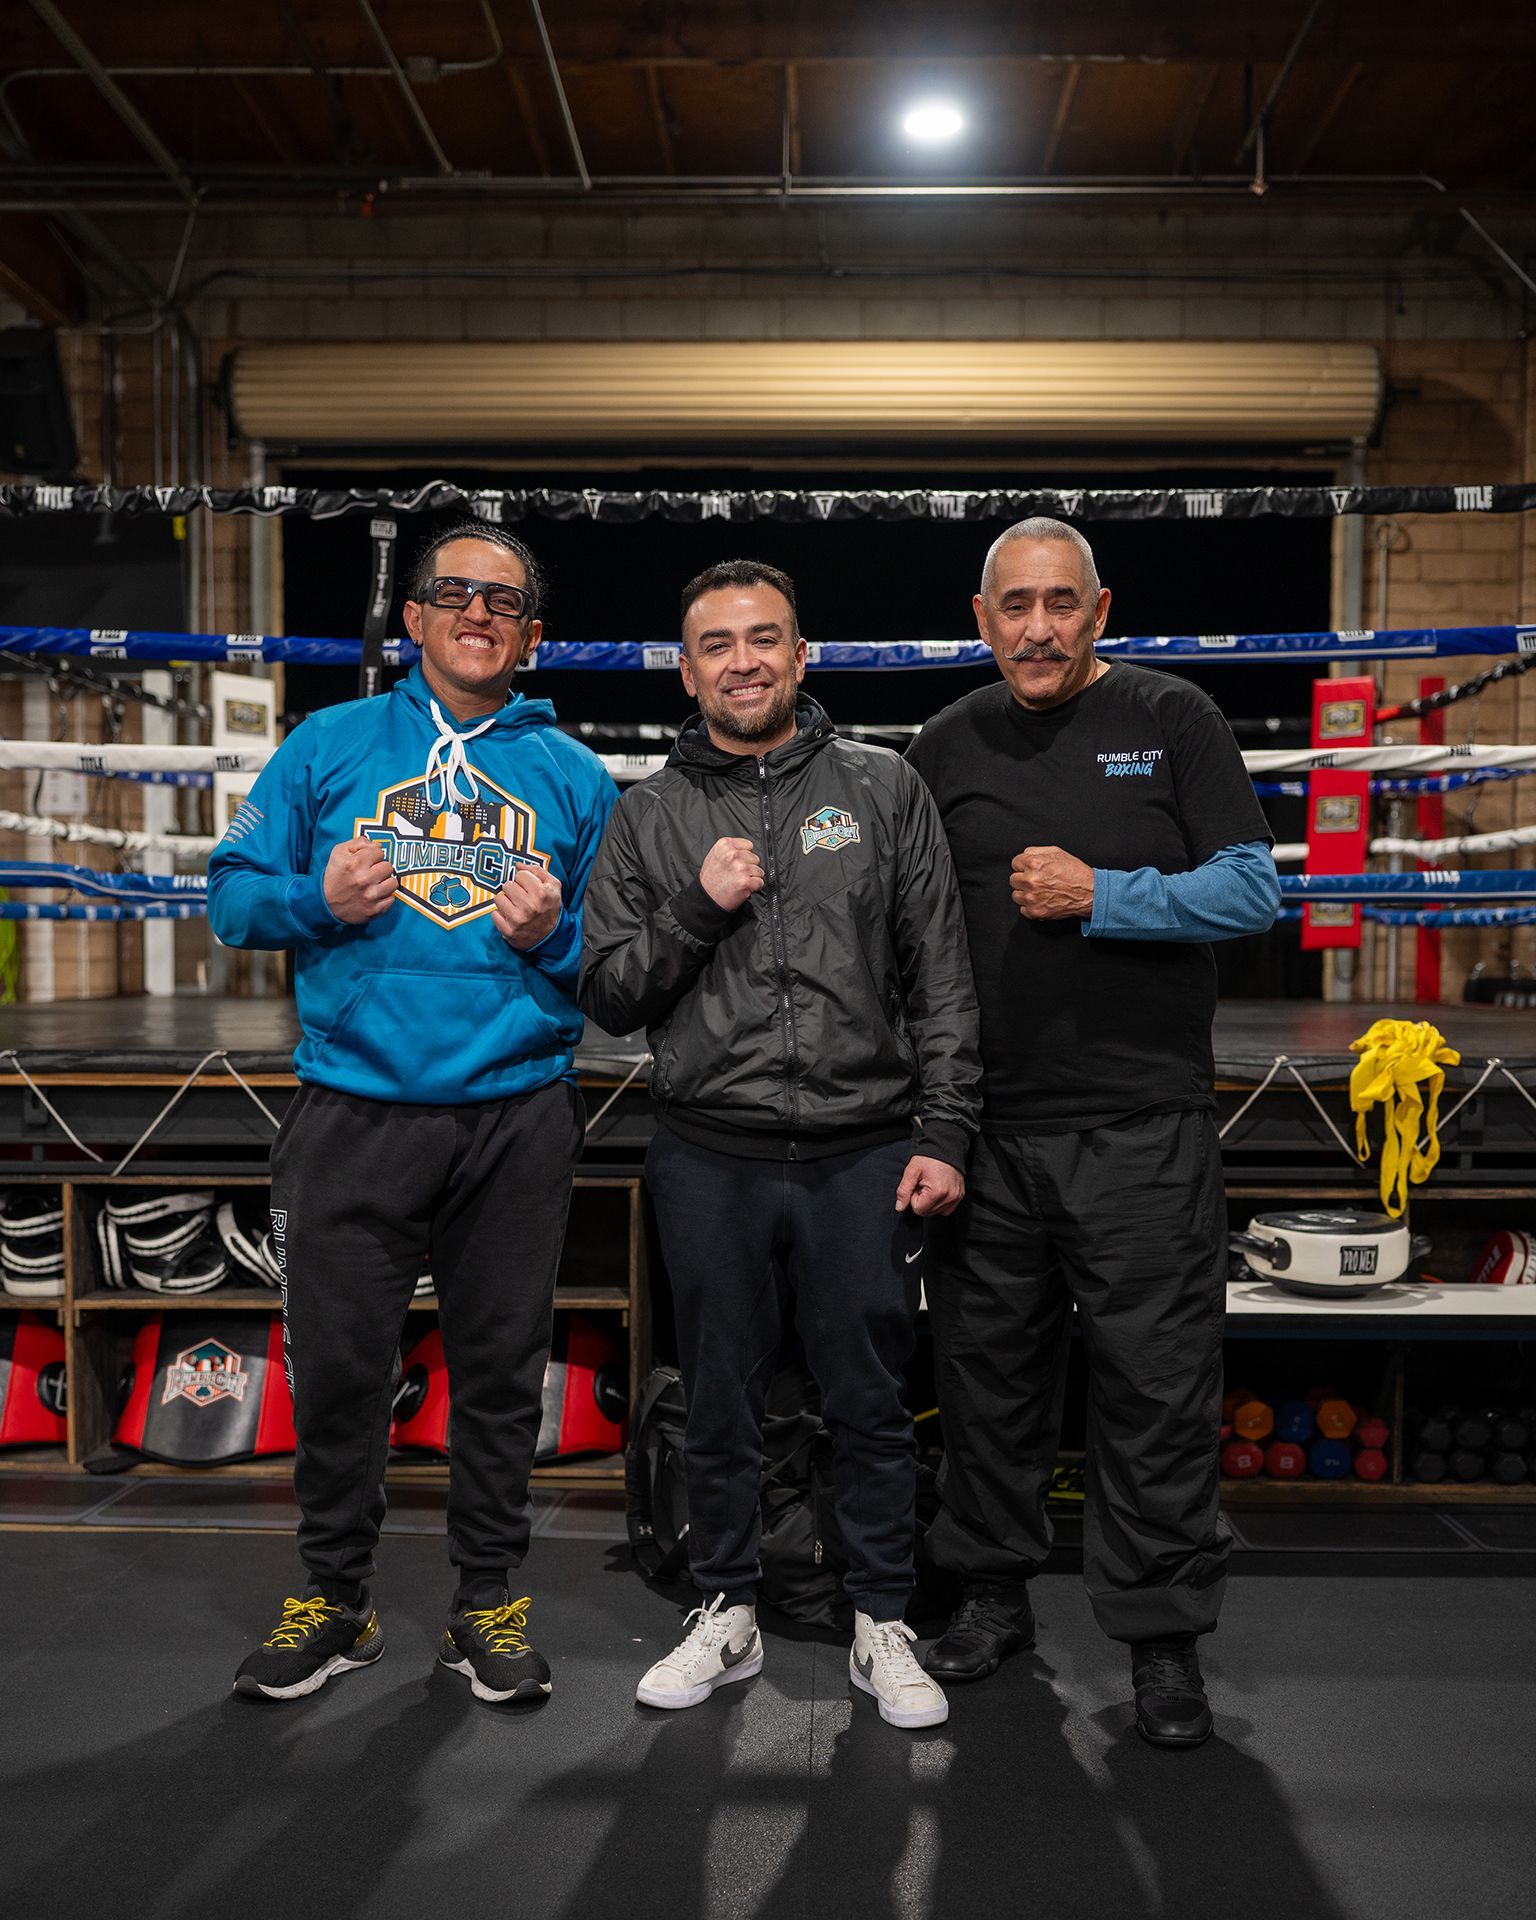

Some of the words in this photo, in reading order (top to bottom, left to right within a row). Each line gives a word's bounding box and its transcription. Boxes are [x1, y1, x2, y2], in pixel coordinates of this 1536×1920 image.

[35, 487, 74, 510] TITLE
[928, 495, 966, 520] TITLE
[1185, 493, 1224, 518] TITLE
[1455, 485, 1493, 511] TITLE
[80, 756, 103, 771] TITLE
[216, 755, 240, 769] TITLE
[1097, 751, 1139, 763] RUMBLE
[1142, 749, 1163, 761] CITY
[1105, 762, 1154, 777] BOXING
